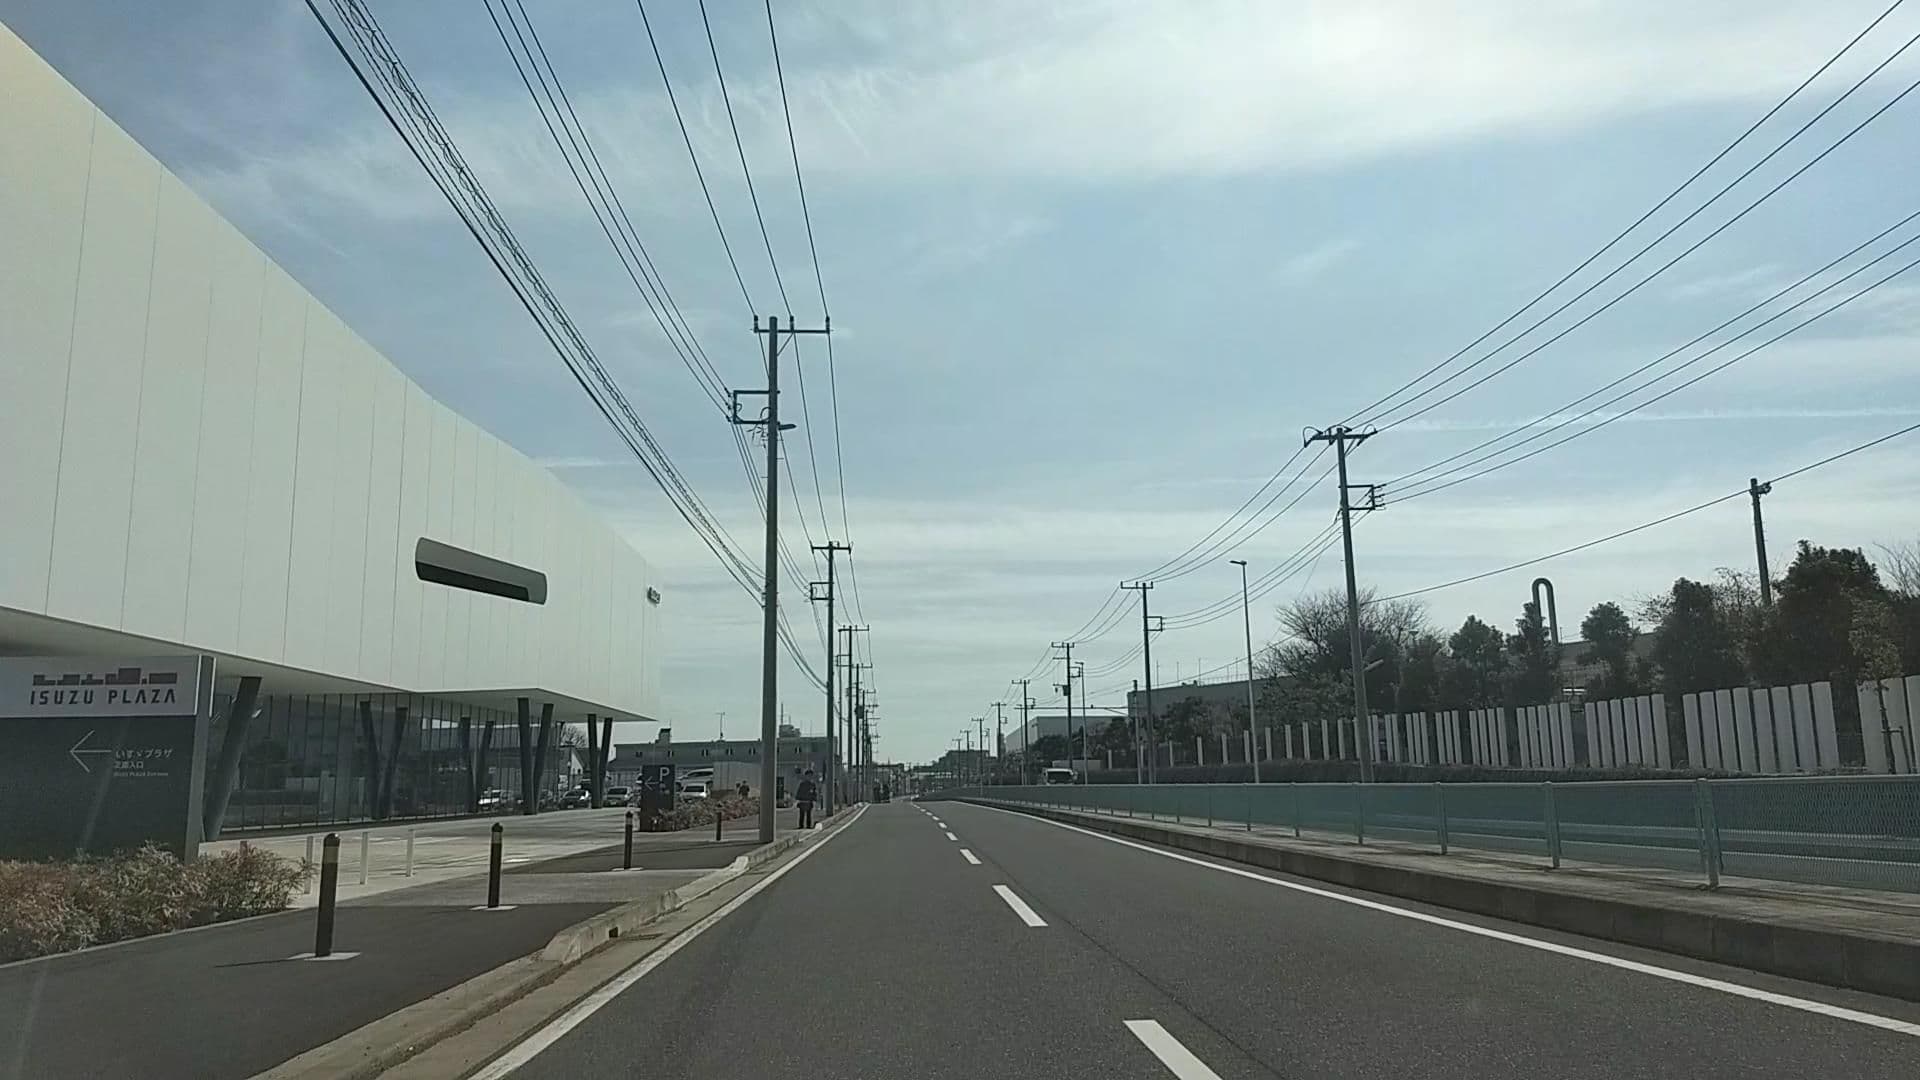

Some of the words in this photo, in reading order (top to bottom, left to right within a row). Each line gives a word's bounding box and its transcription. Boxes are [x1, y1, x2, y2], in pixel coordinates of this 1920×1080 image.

[30, 690, 94, 705] ISUZU
[108, 689, 176, 704] PLAZA
[660, 767, 670, 781] P
